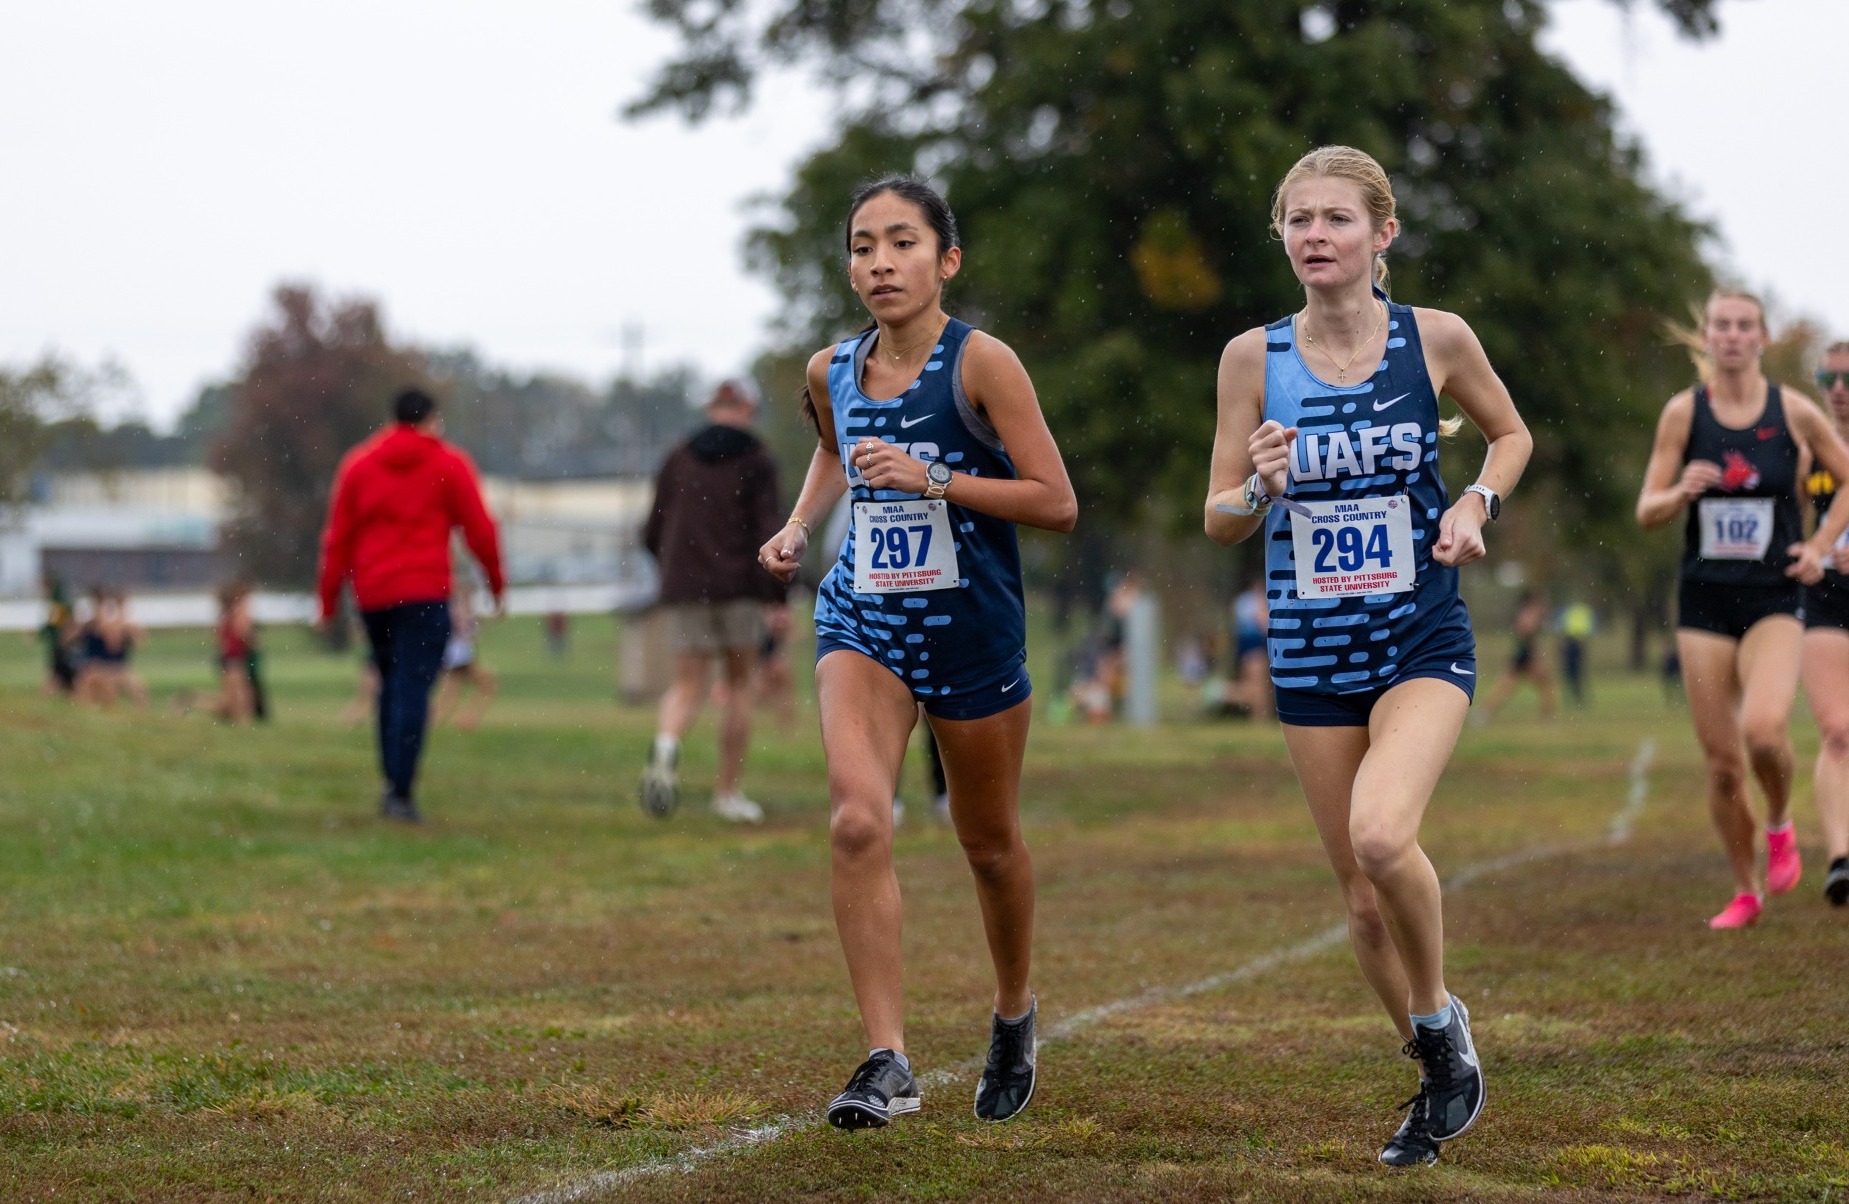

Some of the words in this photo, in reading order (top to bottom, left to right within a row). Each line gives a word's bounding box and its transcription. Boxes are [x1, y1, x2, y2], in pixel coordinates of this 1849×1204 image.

[1289, 422, 1422, 482] UAFS
[882, 505, 905, 514] MIAA
[1334, 503, 1359, 513] MIAA
[869, 515, 888, 523] CROSS
[889, 512, 928, 523] COUNTRY
[1311, 514, 1340, 524] CROSS
[1342, 510, 1387, 522] COUNTRY
[1715, 517, 1758, 542] 102
[870, 524, 933, 569] 297
[1311, 523, 1393, 573] 294
[868, 572, 890, 580] HOSTED
[902, 568, 942, 579] PITTSBURG
[1312, 576, 1340, 585] HOSTED
[1341, 574, 1352, 583] BY
[1353, 571, 1398, 582] PITTSBURG
[875, 580, 894, 588] STATE
[894, 577, 935, 587] UNIVERSITY
[1320, 584, 1343, 593] STATE
[1344, 580, 1390, 592] UNIVERSITY
